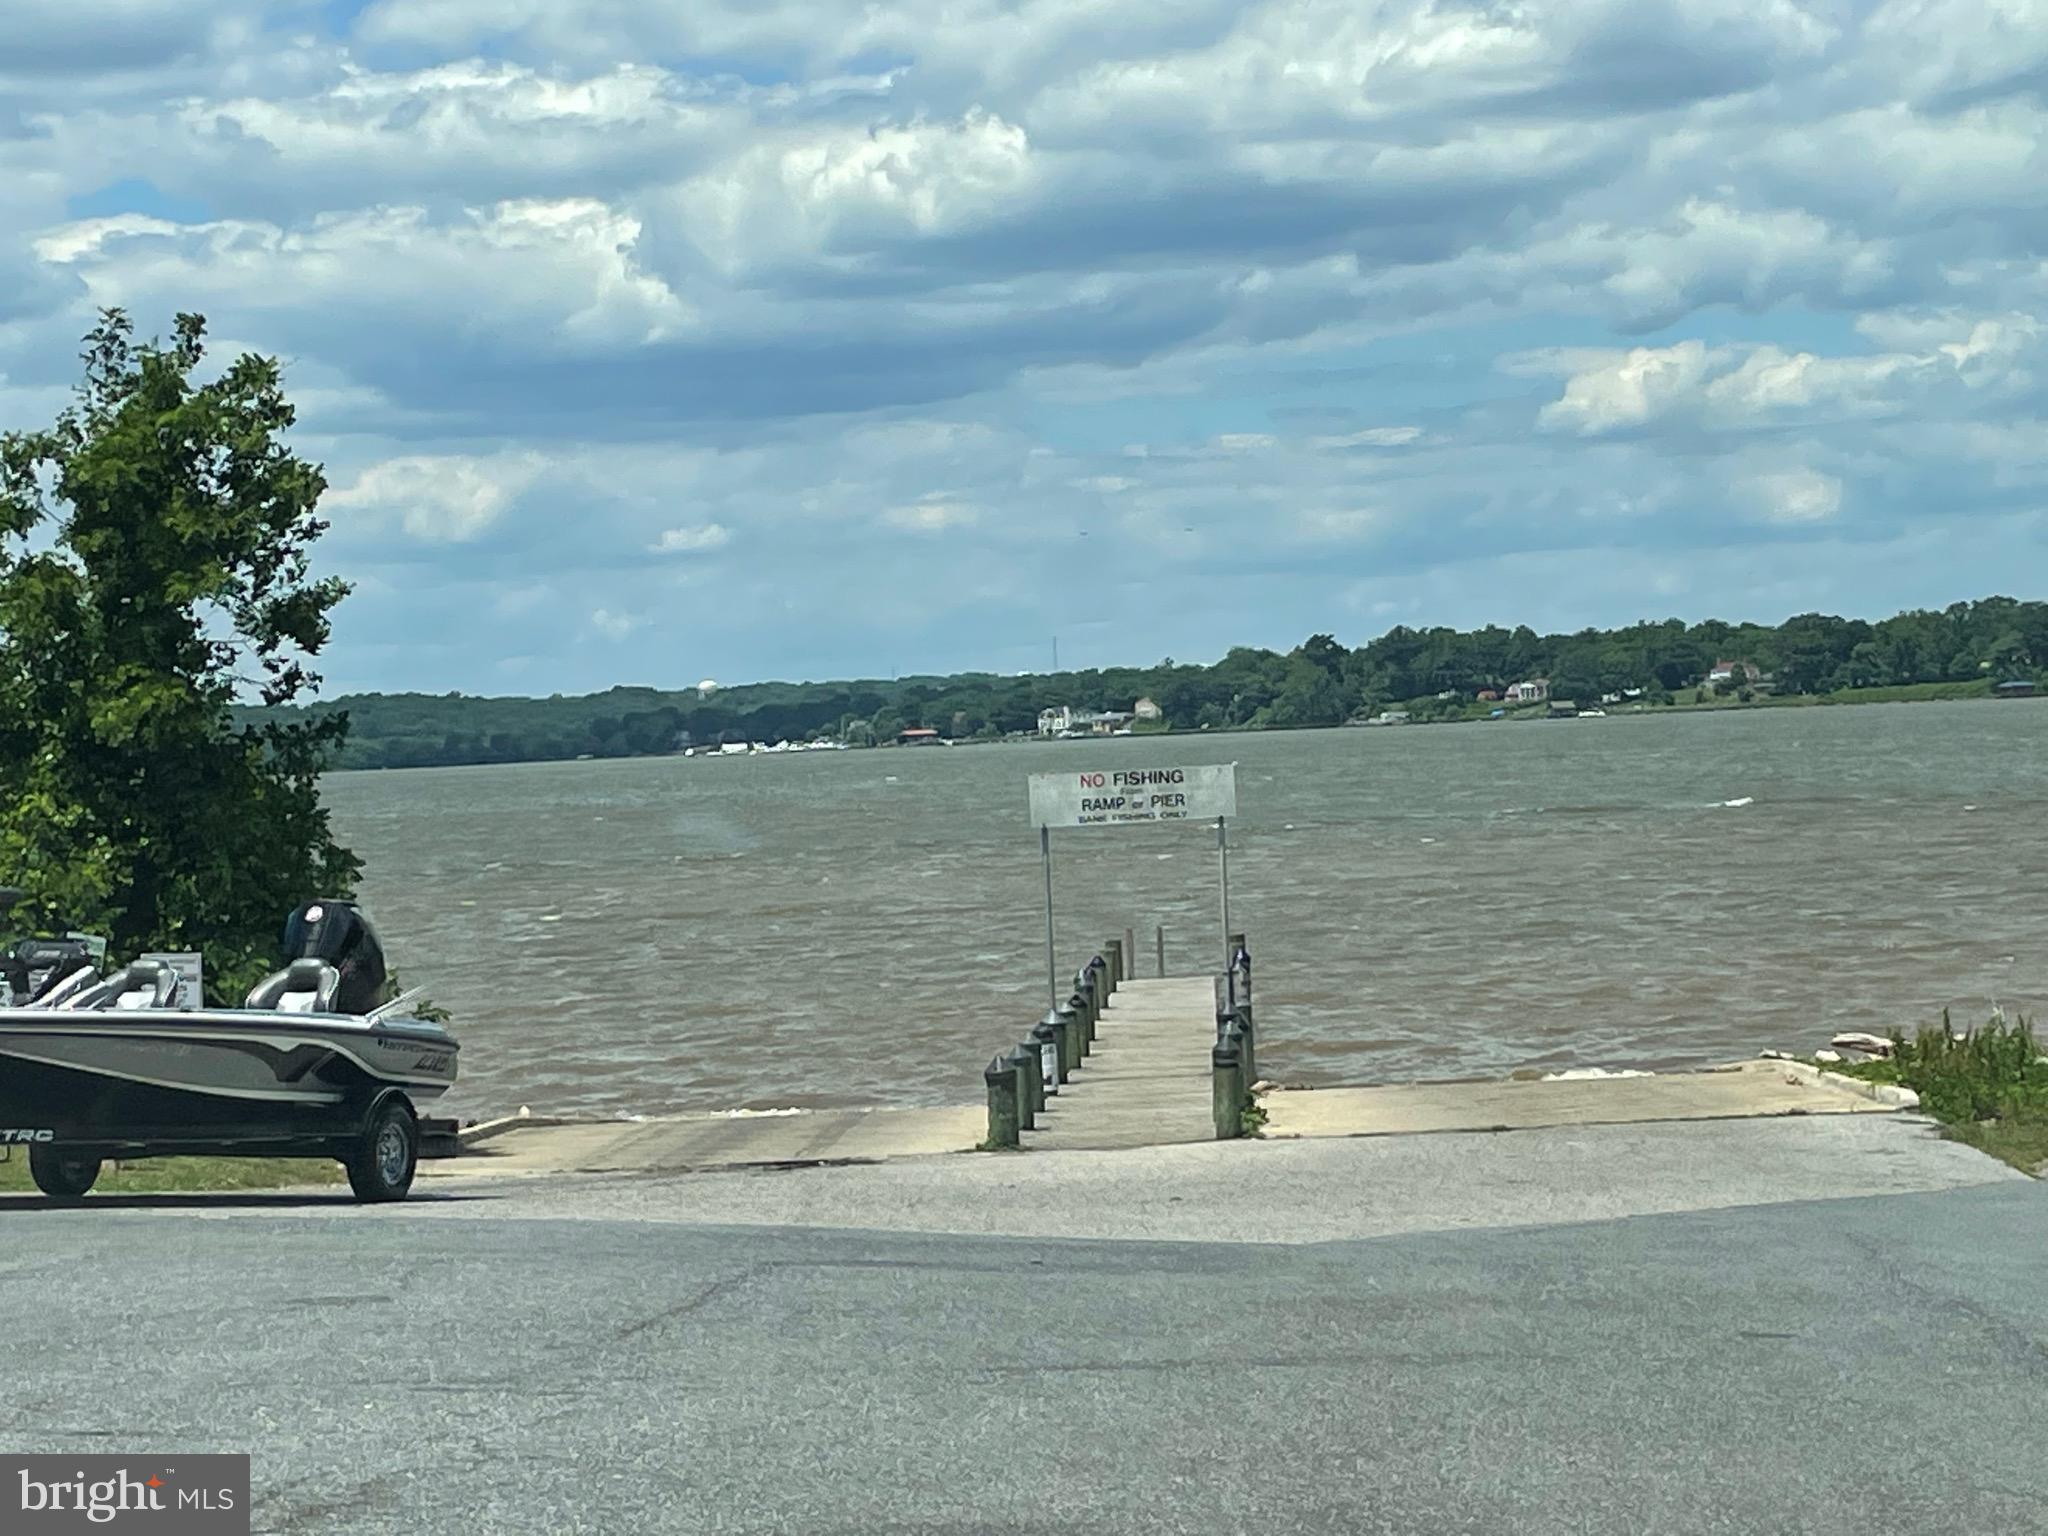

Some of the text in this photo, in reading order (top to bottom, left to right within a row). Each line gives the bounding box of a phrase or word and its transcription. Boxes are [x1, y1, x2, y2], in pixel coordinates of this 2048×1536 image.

[1080, 769, 1184, 788] NO FISHING
[1082, 796, 1125, 811] RAMP
[1151, 793, 1185, 808] PIER
[1160, 811, 1187, 819] ONLY
